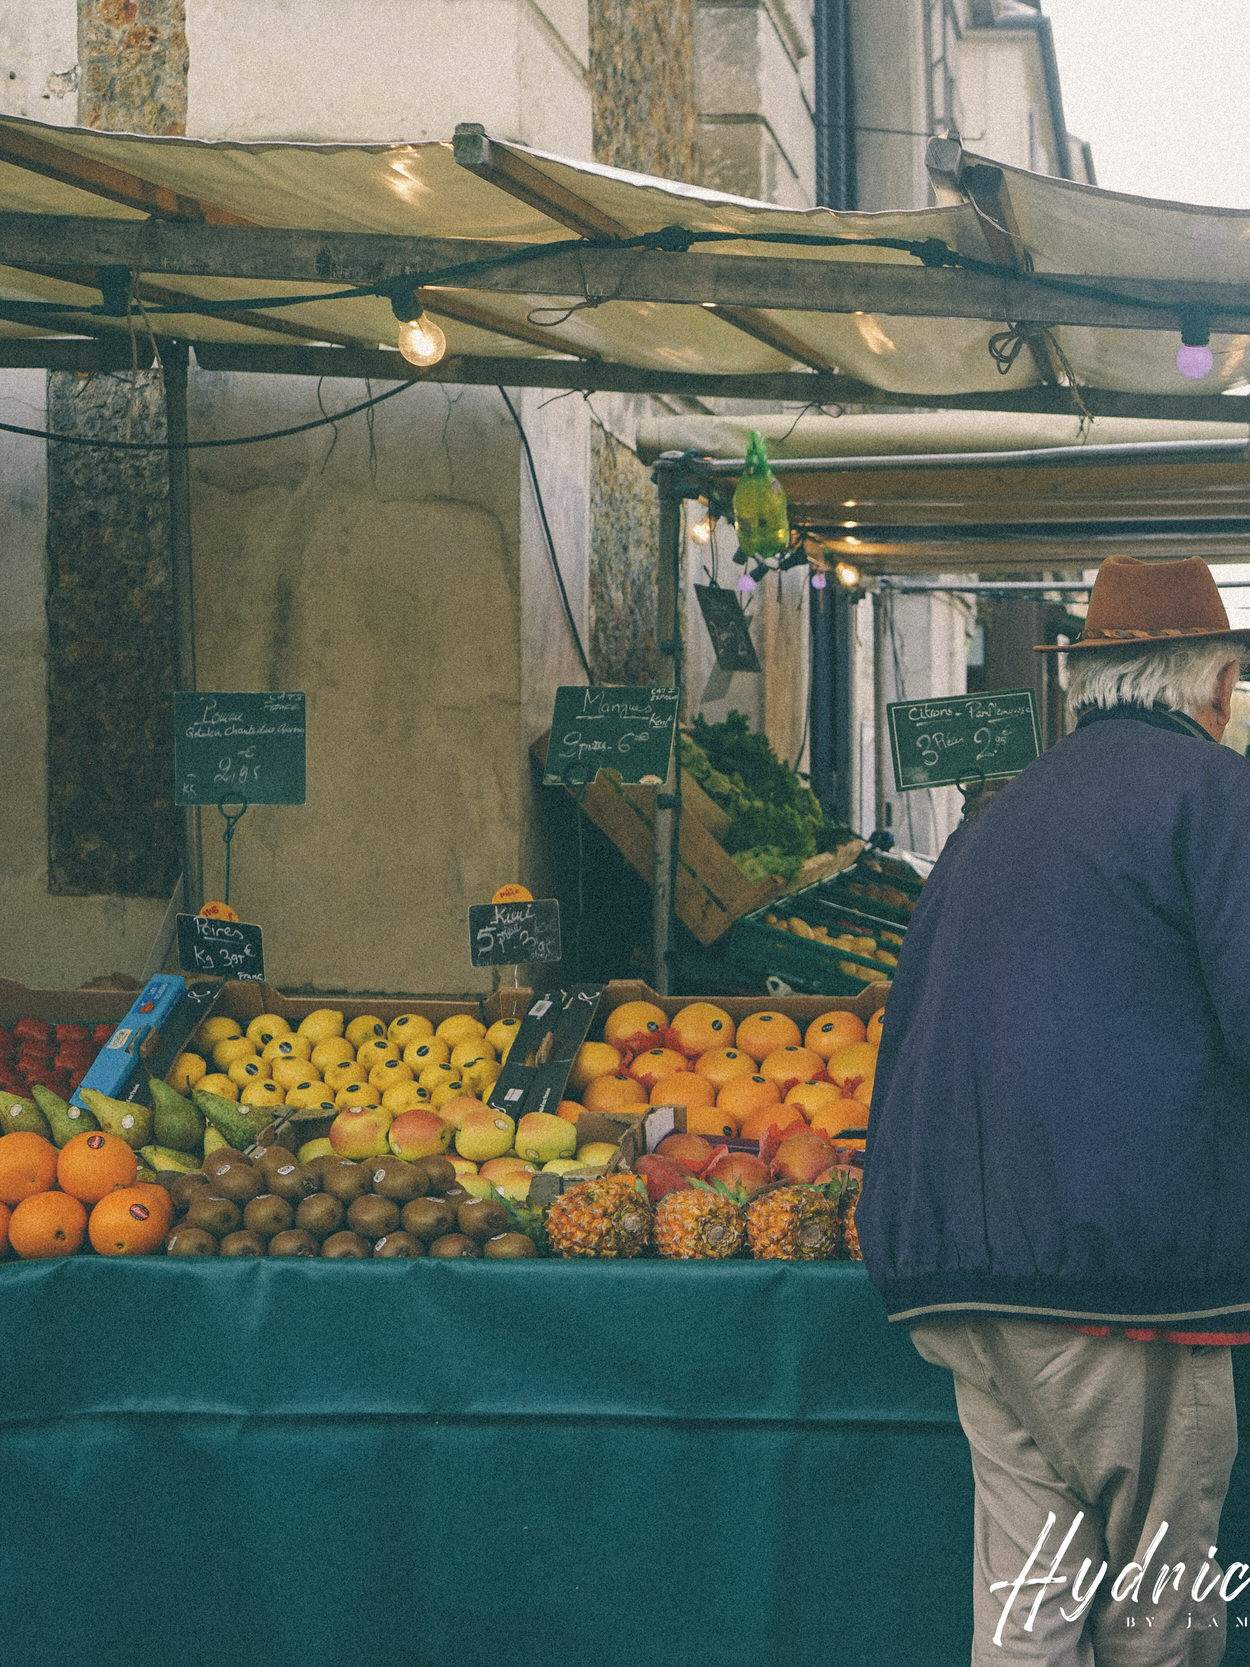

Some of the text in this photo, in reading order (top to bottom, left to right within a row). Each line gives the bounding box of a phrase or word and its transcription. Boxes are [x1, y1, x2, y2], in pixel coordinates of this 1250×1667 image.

[908, 703, 953, 721] Citrons
[916, 733, 939, 766] 3
[193, 915, 244, 940] Poires
[194, 944, 215, 969] Kg
